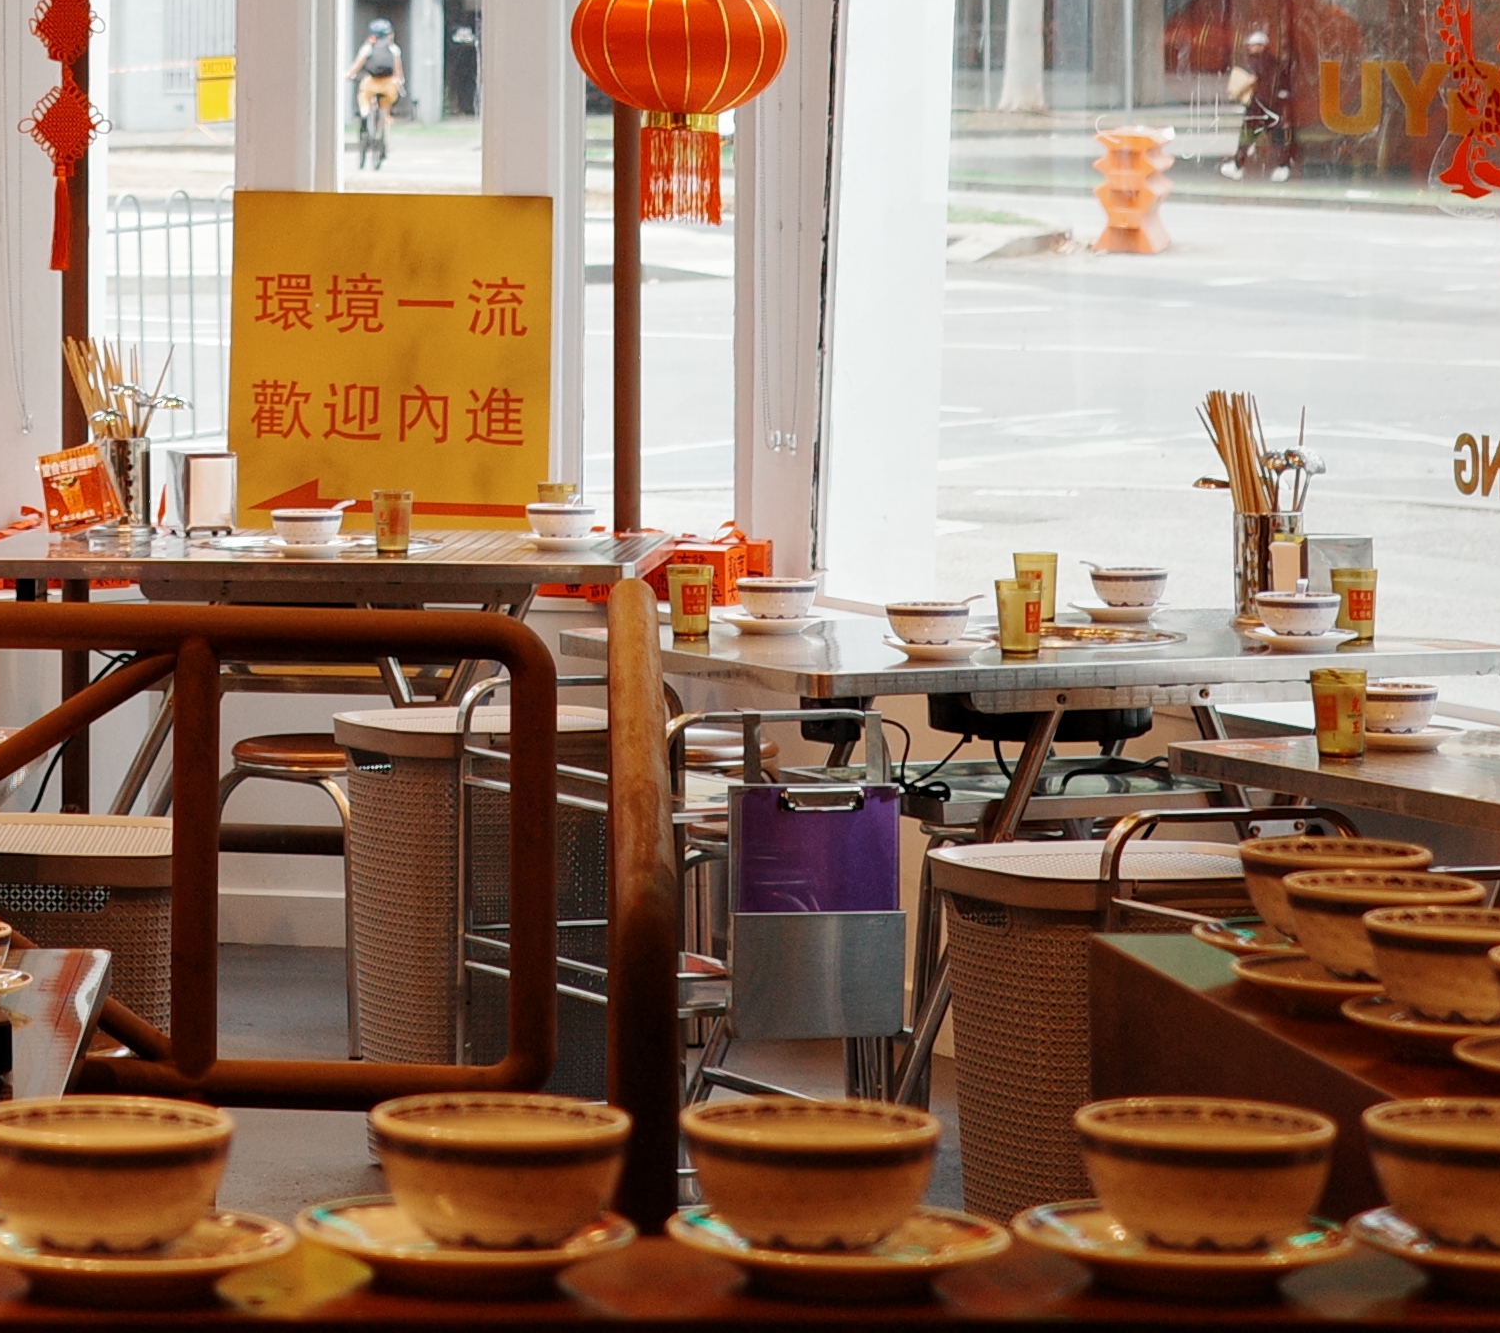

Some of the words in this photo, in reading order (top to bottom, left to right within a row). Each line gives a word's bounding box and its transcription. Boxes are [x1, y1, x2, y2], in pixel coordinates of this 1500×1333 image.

[253, 271, 530, 339] 環境一流
[249, 378, 527, 449] 歡迎內進
